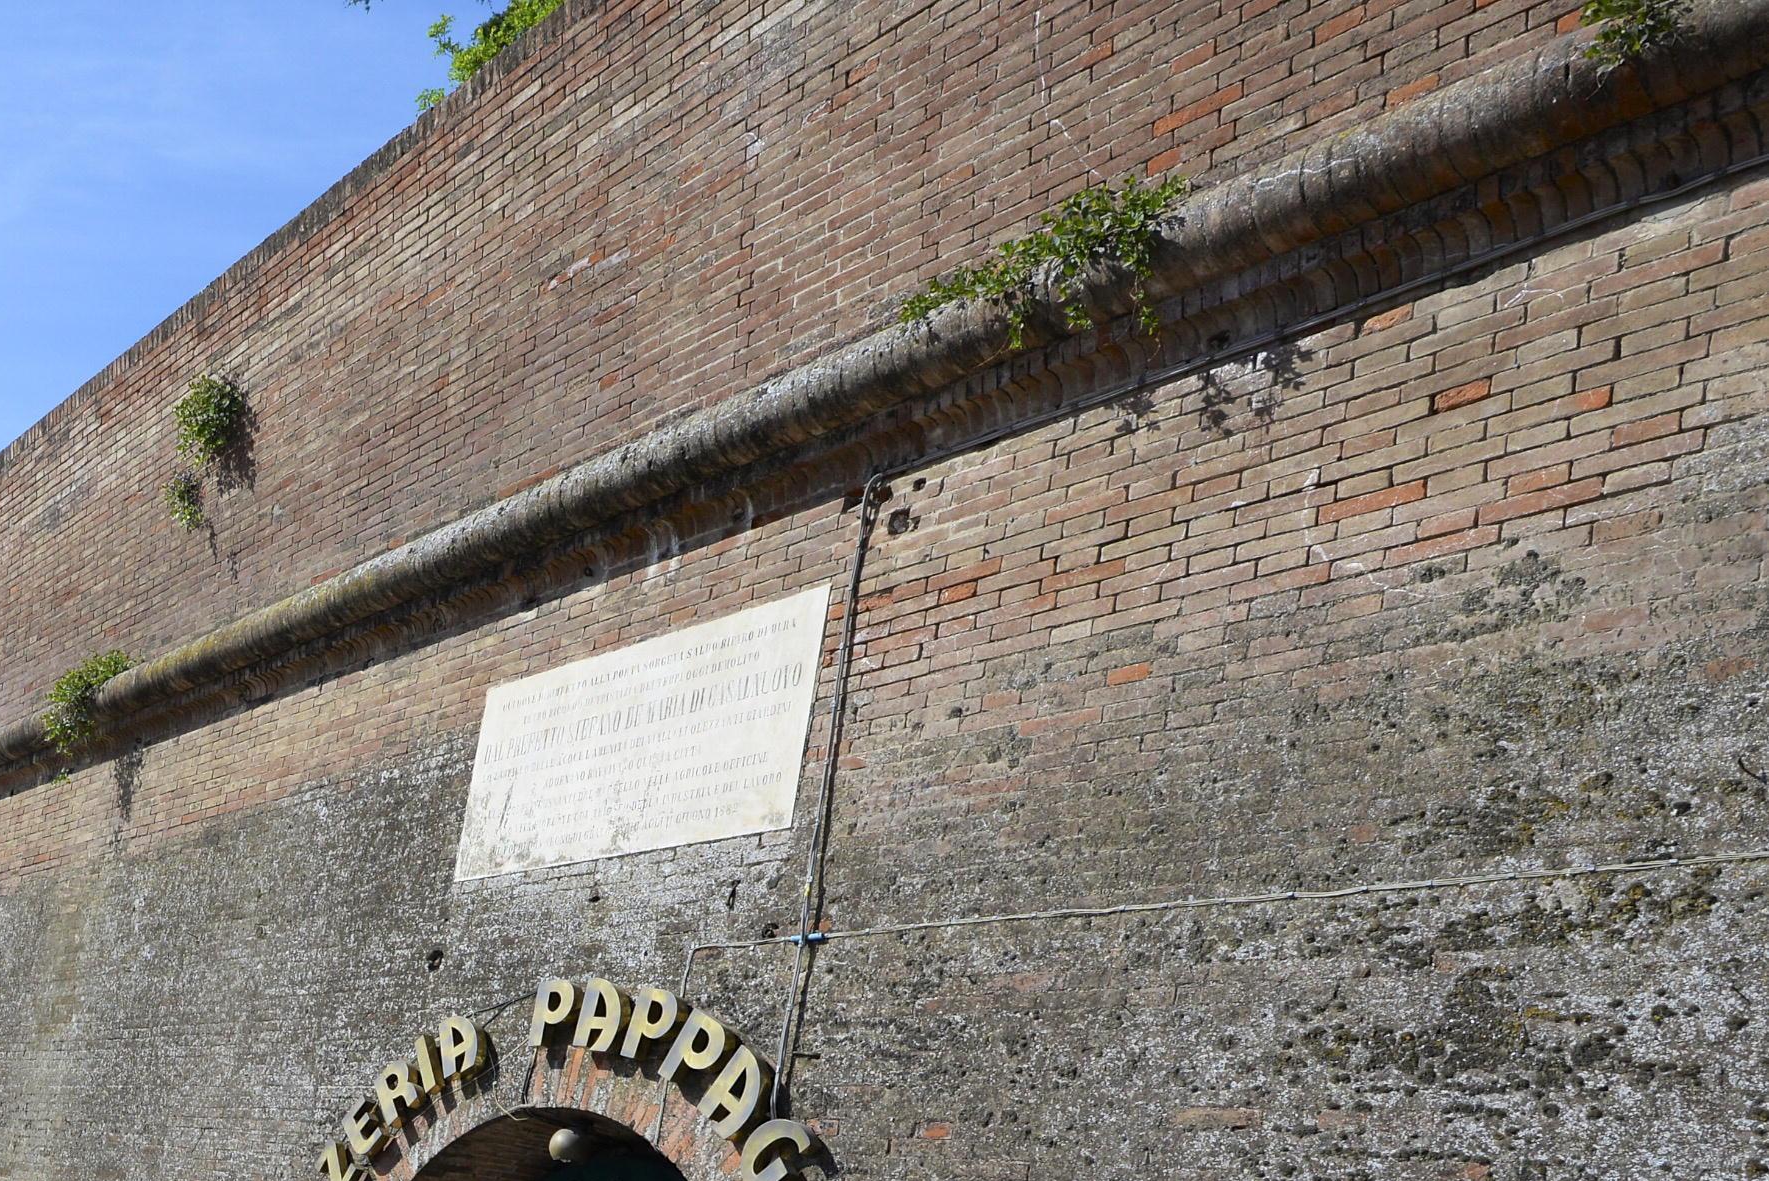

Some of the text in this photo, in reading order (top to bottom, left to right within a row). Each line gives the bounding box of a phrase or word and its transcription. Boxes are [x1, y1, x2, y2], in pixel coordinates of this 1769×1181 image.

[482, 738, 506, 765] DAL
[505, 722, 566, 760] PREFETTO
[565, 707, 623, 744] STEFANO
[644, 690, 688, 725] MARIA
